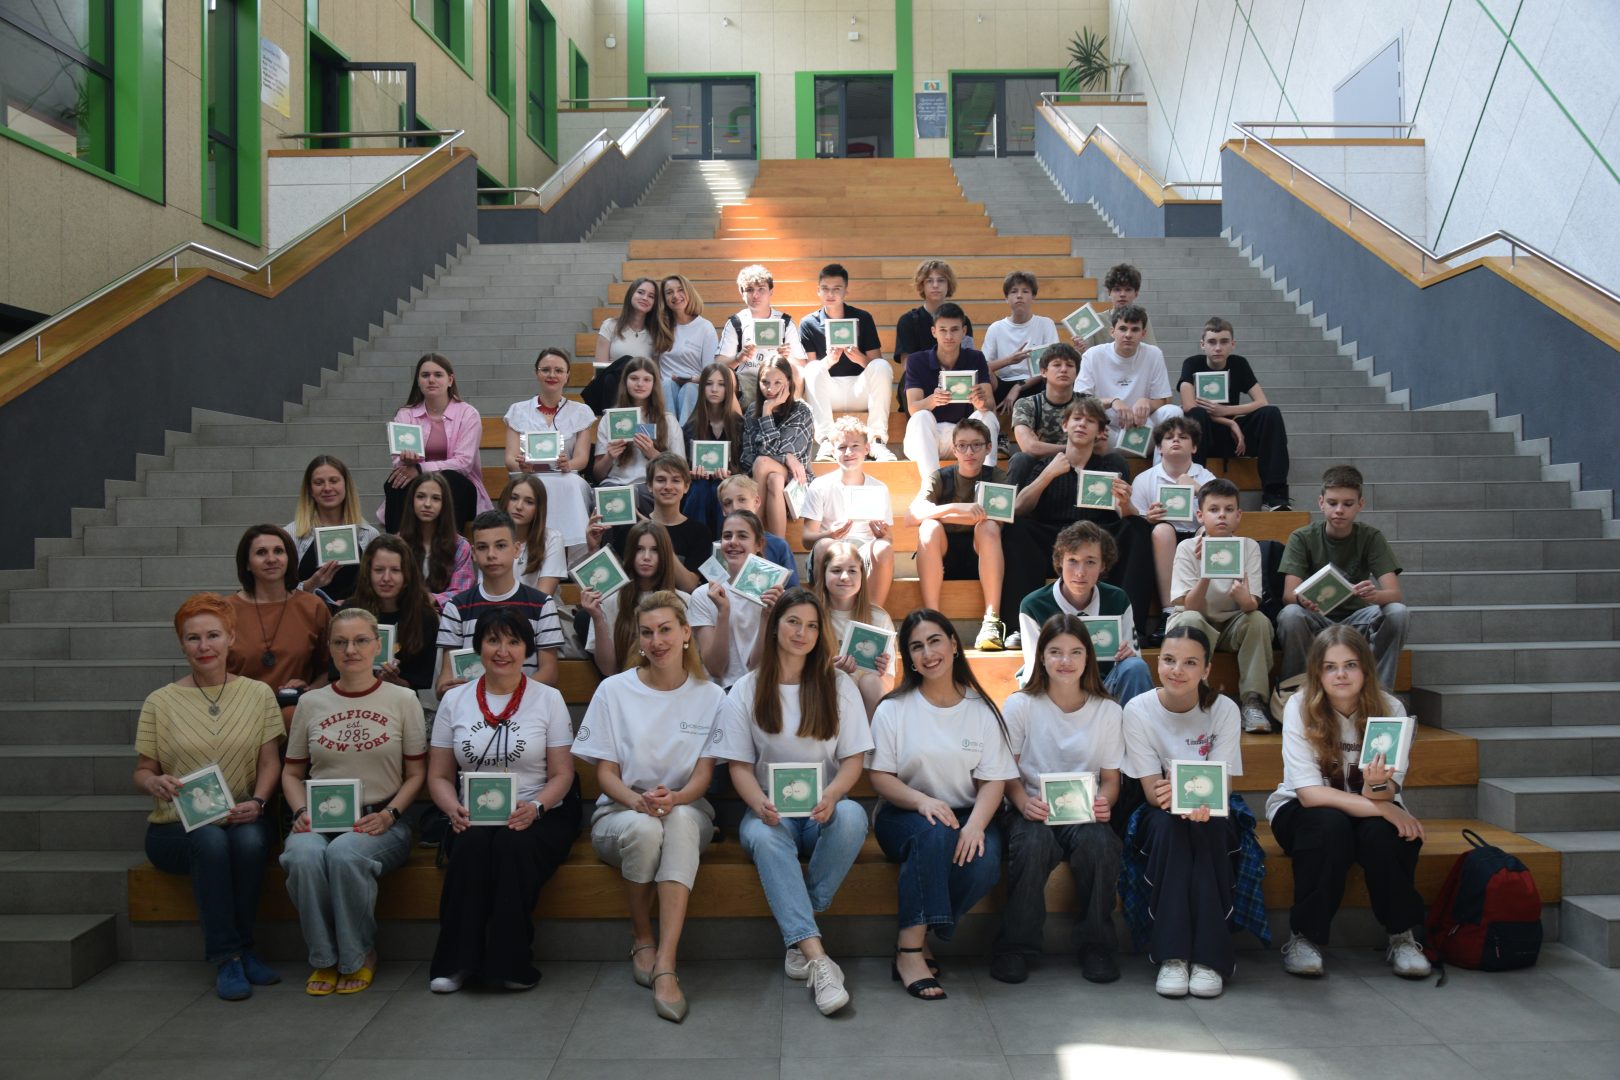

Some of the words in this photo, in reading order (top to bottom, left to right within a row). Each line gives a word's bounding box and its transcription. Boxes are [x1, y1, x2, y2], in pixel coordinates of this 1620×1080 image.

[319, 709, 388, 729] HILFIGER
[317, 735, 350, 751] NEW
[354, 732, 391, 751] YORK
[337, 728, 370, 742] 1985
